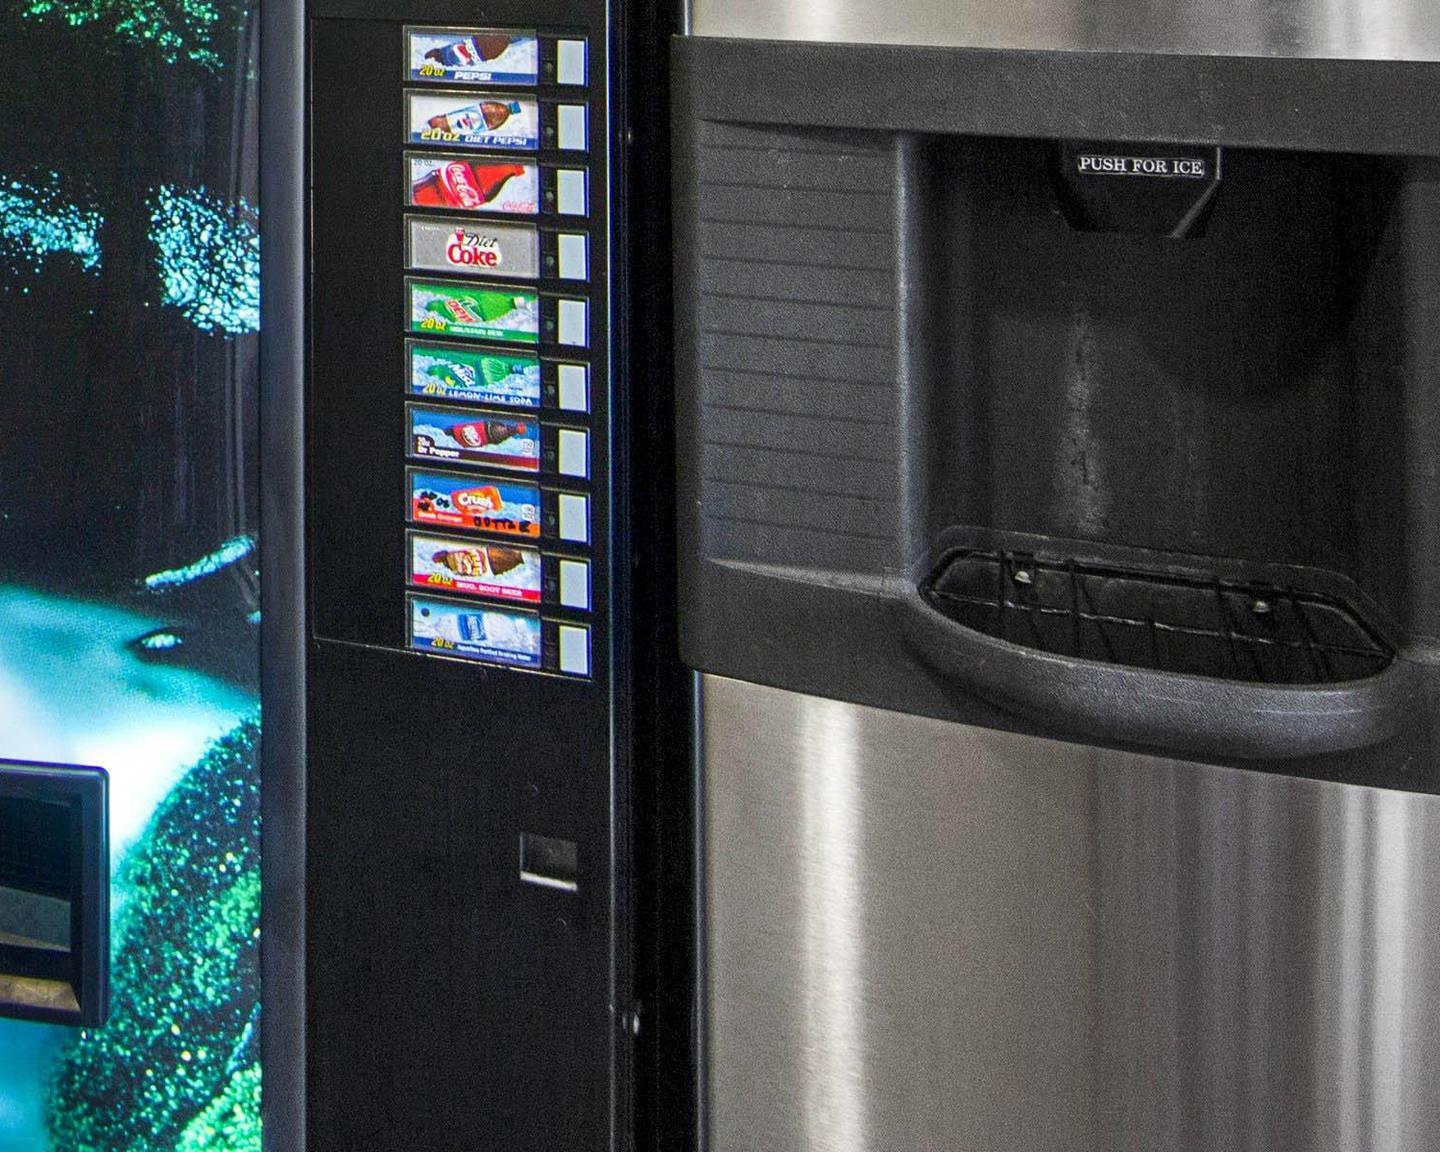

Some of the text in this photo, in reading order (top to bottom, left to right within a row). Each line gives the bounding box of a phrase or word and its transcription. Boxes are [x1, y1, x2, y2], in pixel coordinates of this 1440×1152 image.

[419, 65, 433, 76] 20
[454, 71, 493, 81] PEPSI
[420, 128, 440, 141] 20
[464, 135, 491, 143] DIET
[493, 137, 528, 146] PEPSI
[1080, 157, 1203, 175] PUSH FOR ICE
[464, 235, 498, 248] Diet
[448, 244, 498, 267] Coke
[421, 318, 435, 329] 20
[423, 383, 436, 394] 20
[448, 390, 506, 401] LEMON-LIME
[508, 395, 533, 405] SODA
[417, 445, 460, 458] Dr Pepper
[457, 492, 494, 508] Crush
[427, 572, 441, 583] 20
[479, 584, 501, 593] ROOT
[502, 588, 523, 597] BEER
[431, 636, 444, 648] 20
